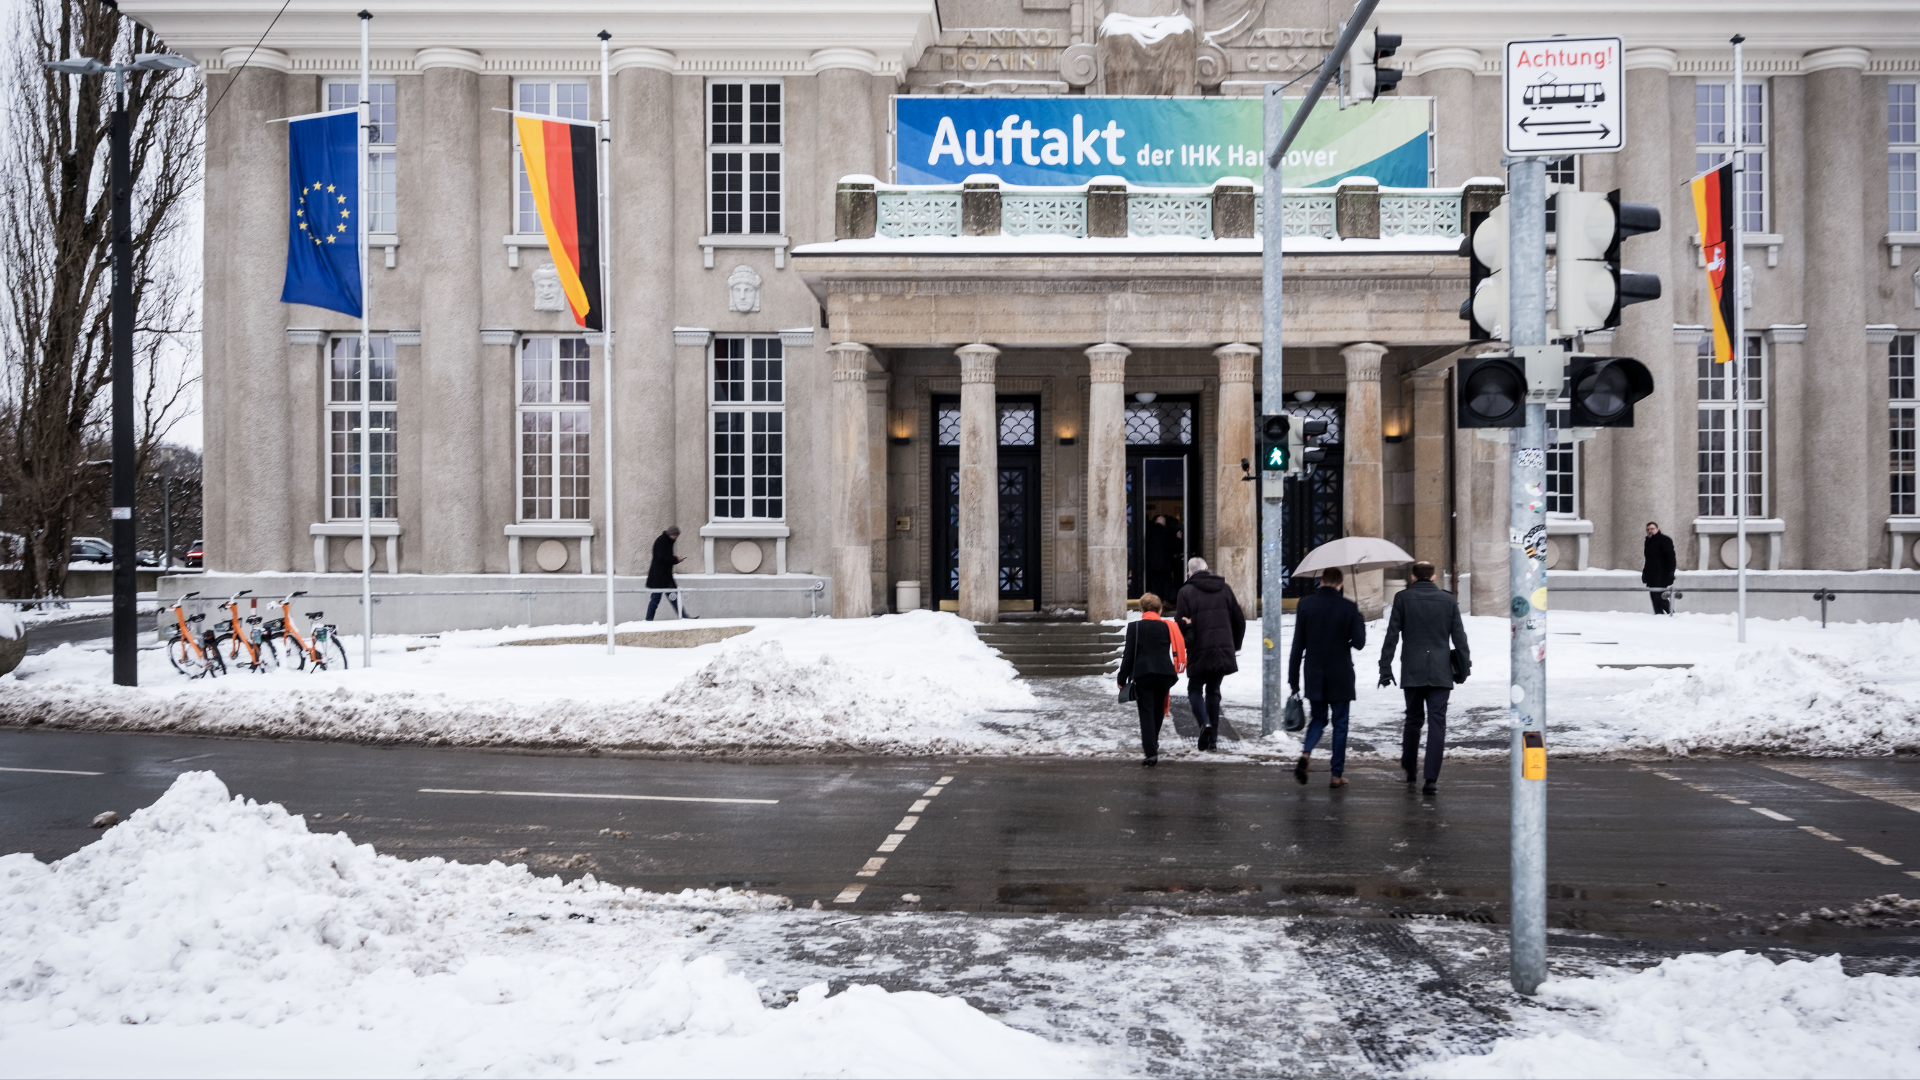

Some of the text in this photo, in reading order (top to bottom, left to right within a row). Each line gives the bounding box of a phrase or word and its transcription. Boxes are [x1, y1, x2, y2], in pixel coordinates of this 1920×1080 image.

[960, 29, 1052, 47] ANNO
[941, 51, 1048, 70] DOMINI
[1517, 46, 1612, 69] Achtung!
[927, 113, 1338, 167] Auftakt der IHK Haover
